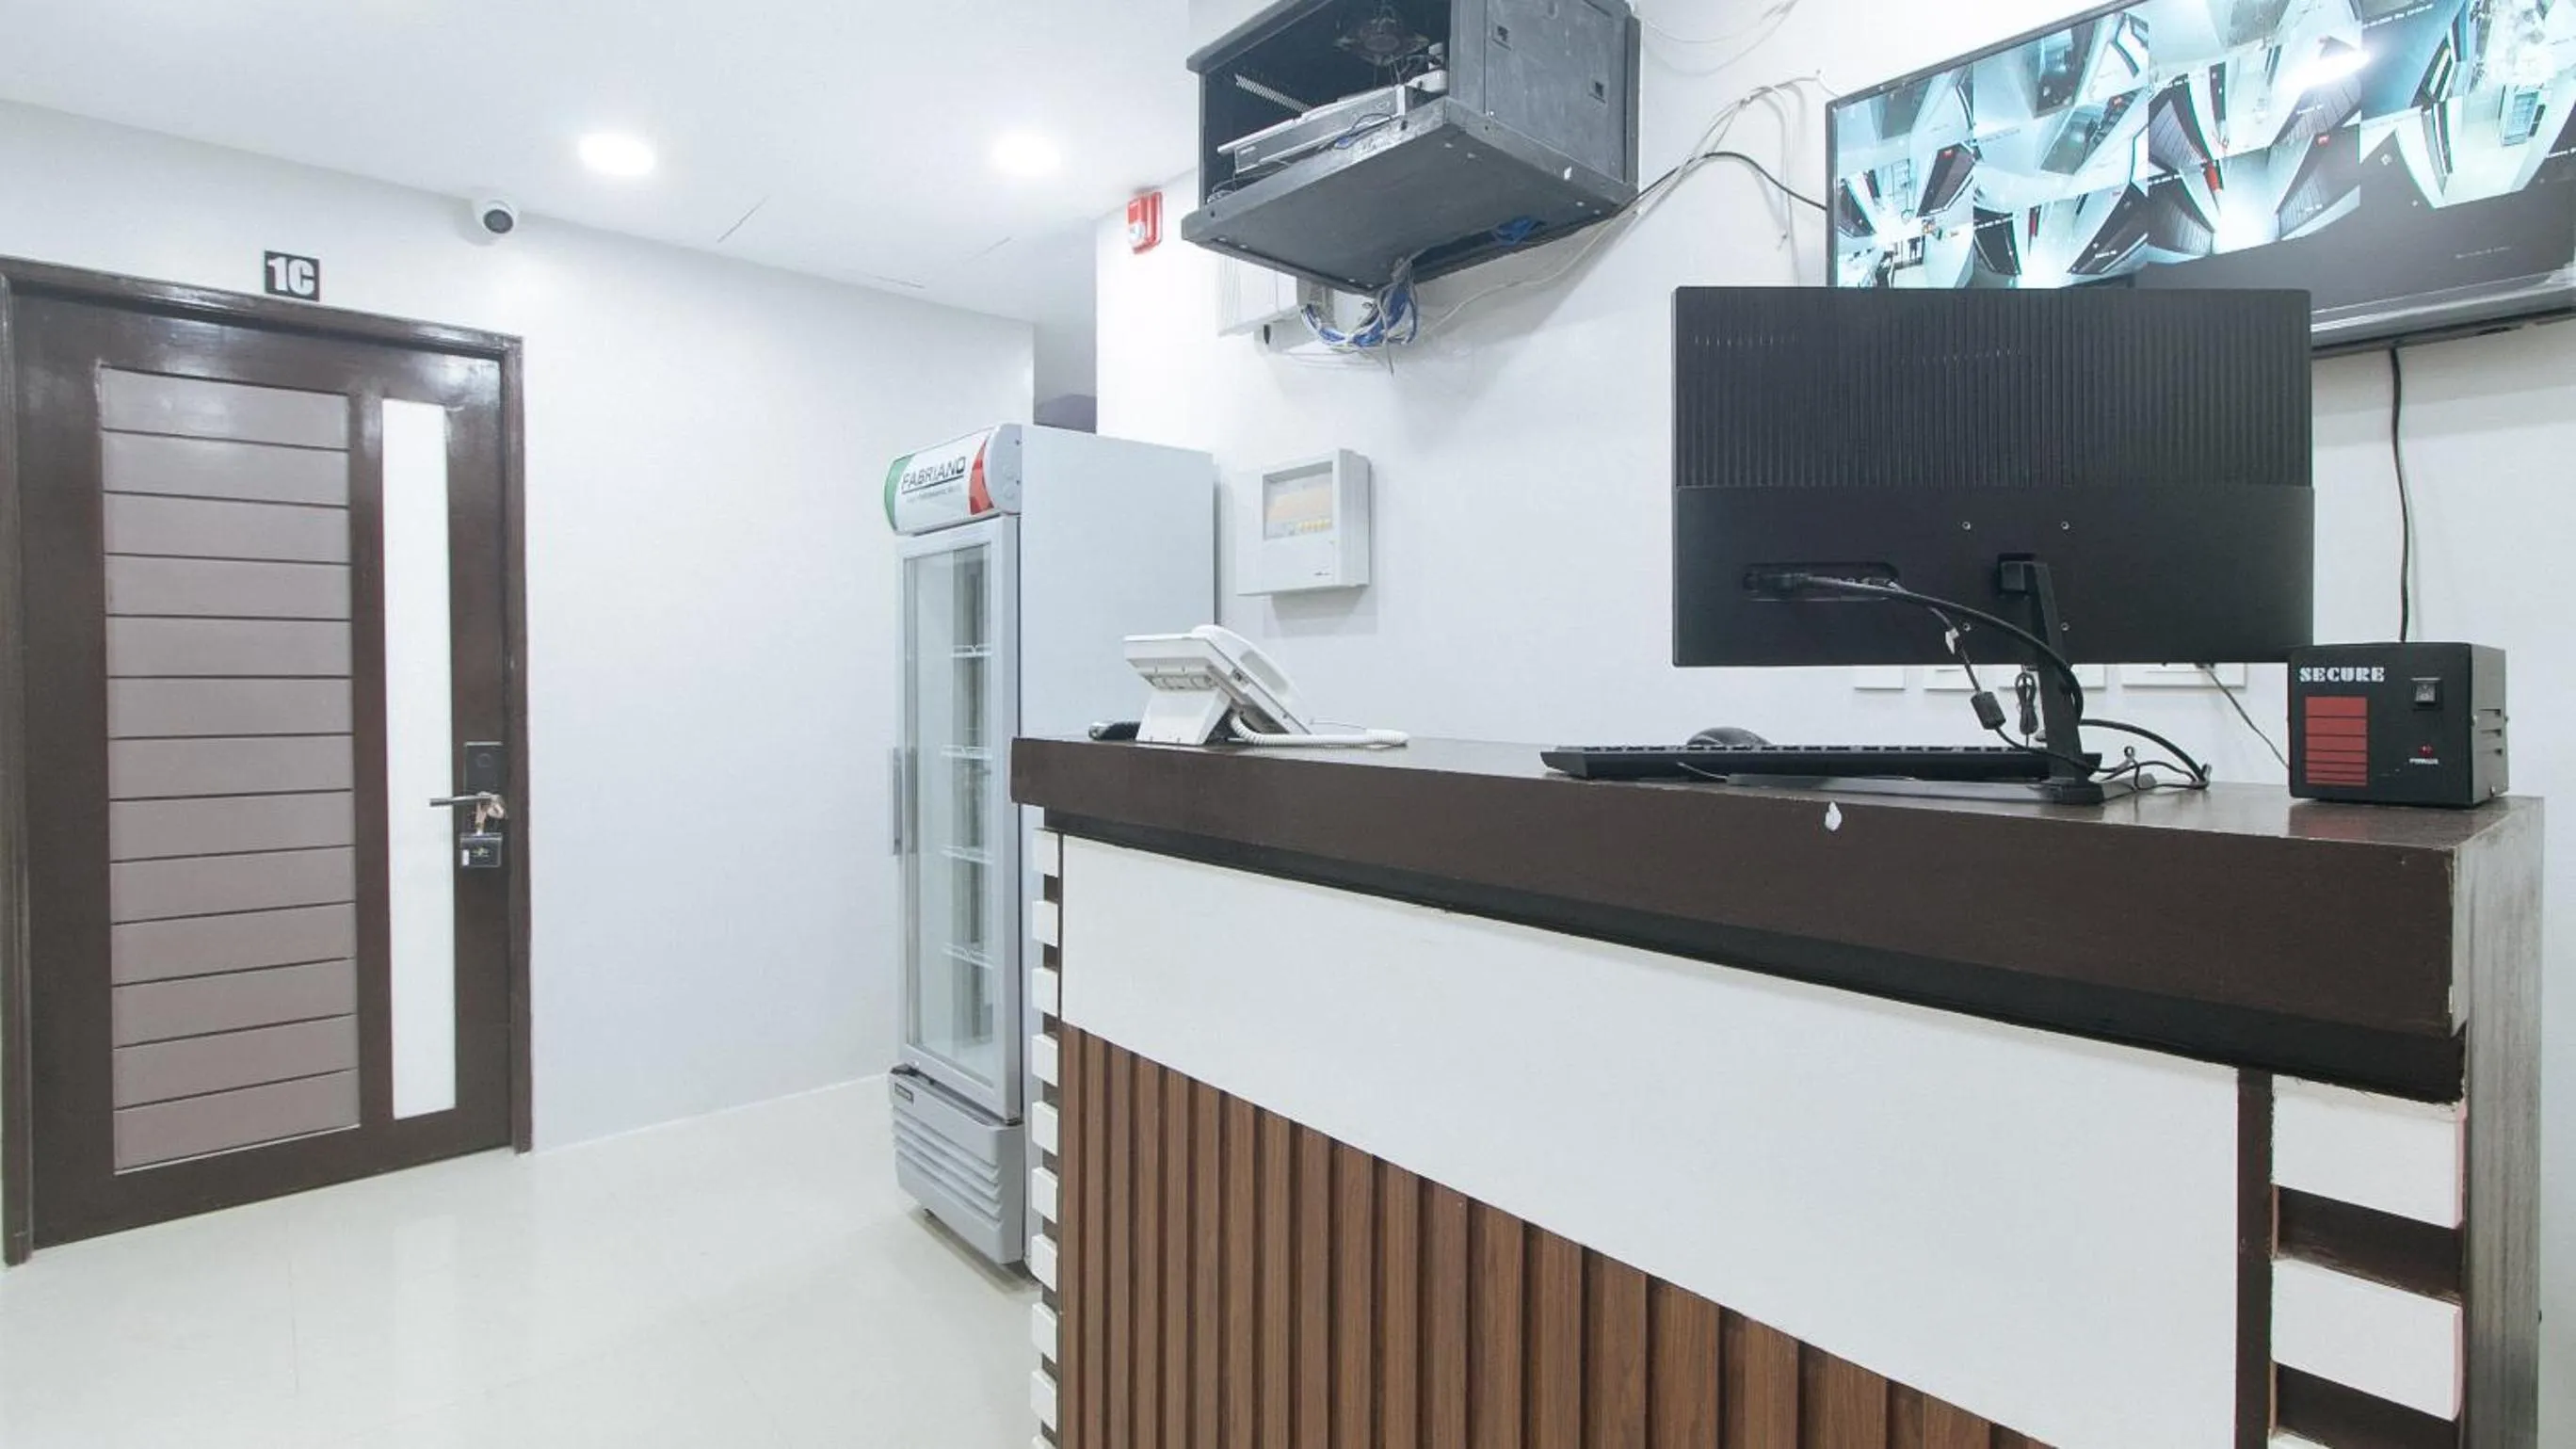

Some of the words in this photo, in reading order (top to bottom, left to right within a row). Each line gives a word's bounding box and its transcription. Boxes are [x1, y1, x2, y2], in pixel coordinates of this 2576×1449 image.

[267, 256, 315, 296] 1C
[900, 456, 966, 490] FABRIANO
[2299, 667, 2385, 683] SECURE
